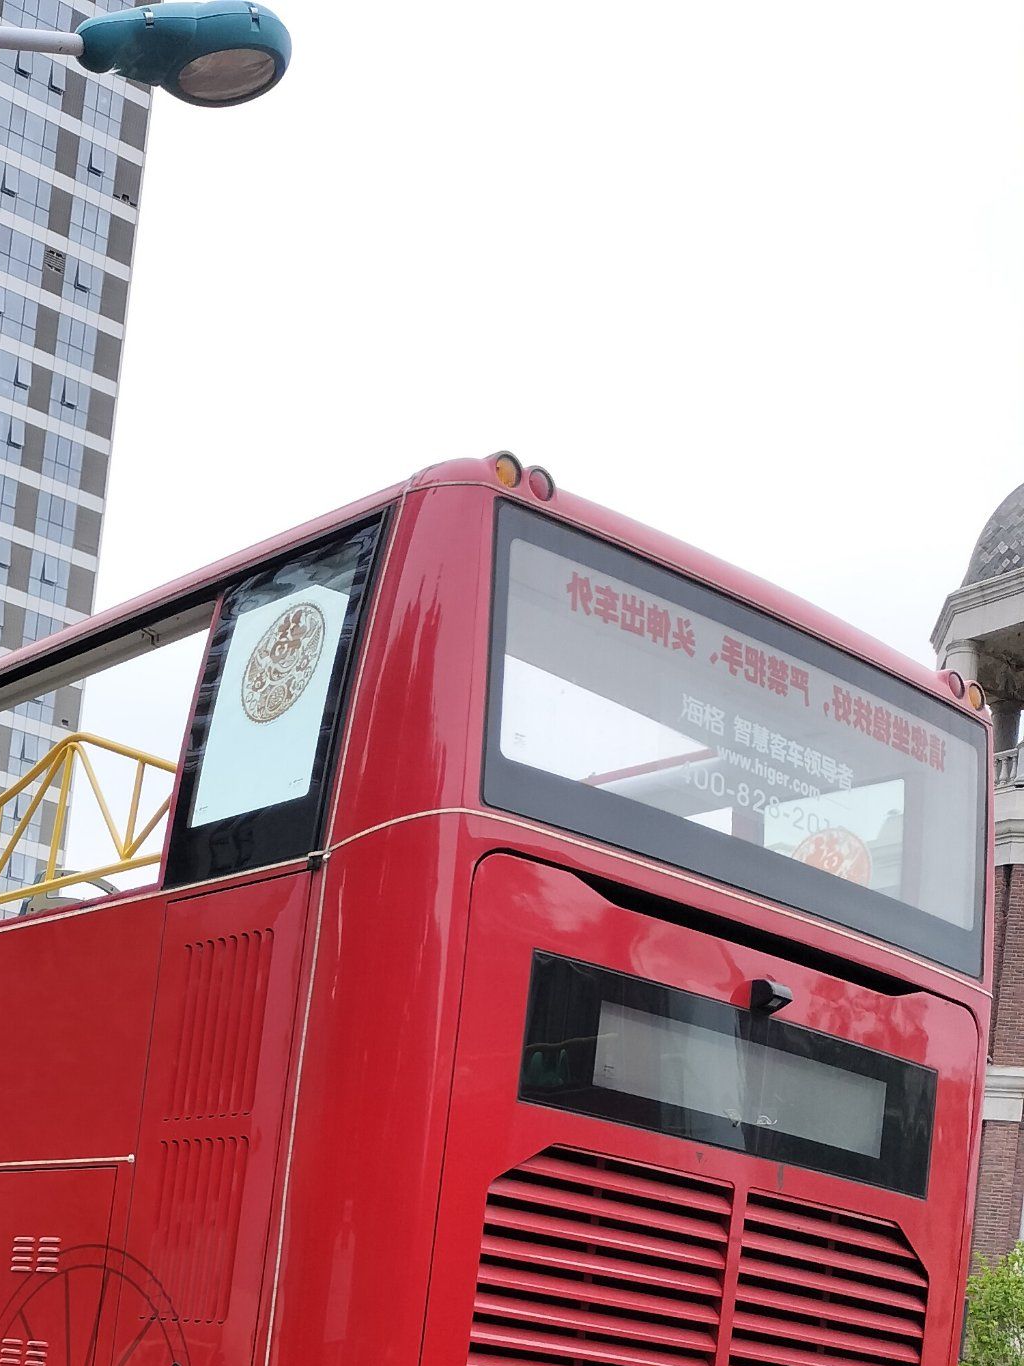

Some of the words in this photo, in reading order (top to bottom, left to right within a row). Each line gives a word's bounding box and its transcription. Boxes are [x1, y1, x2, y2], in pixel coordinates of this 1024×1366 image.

[680, 692, 725, 737] 海格
[734, 713, 854, 793] 智慧客车领导者
[717, 745, 821, 801] www.higer.com
